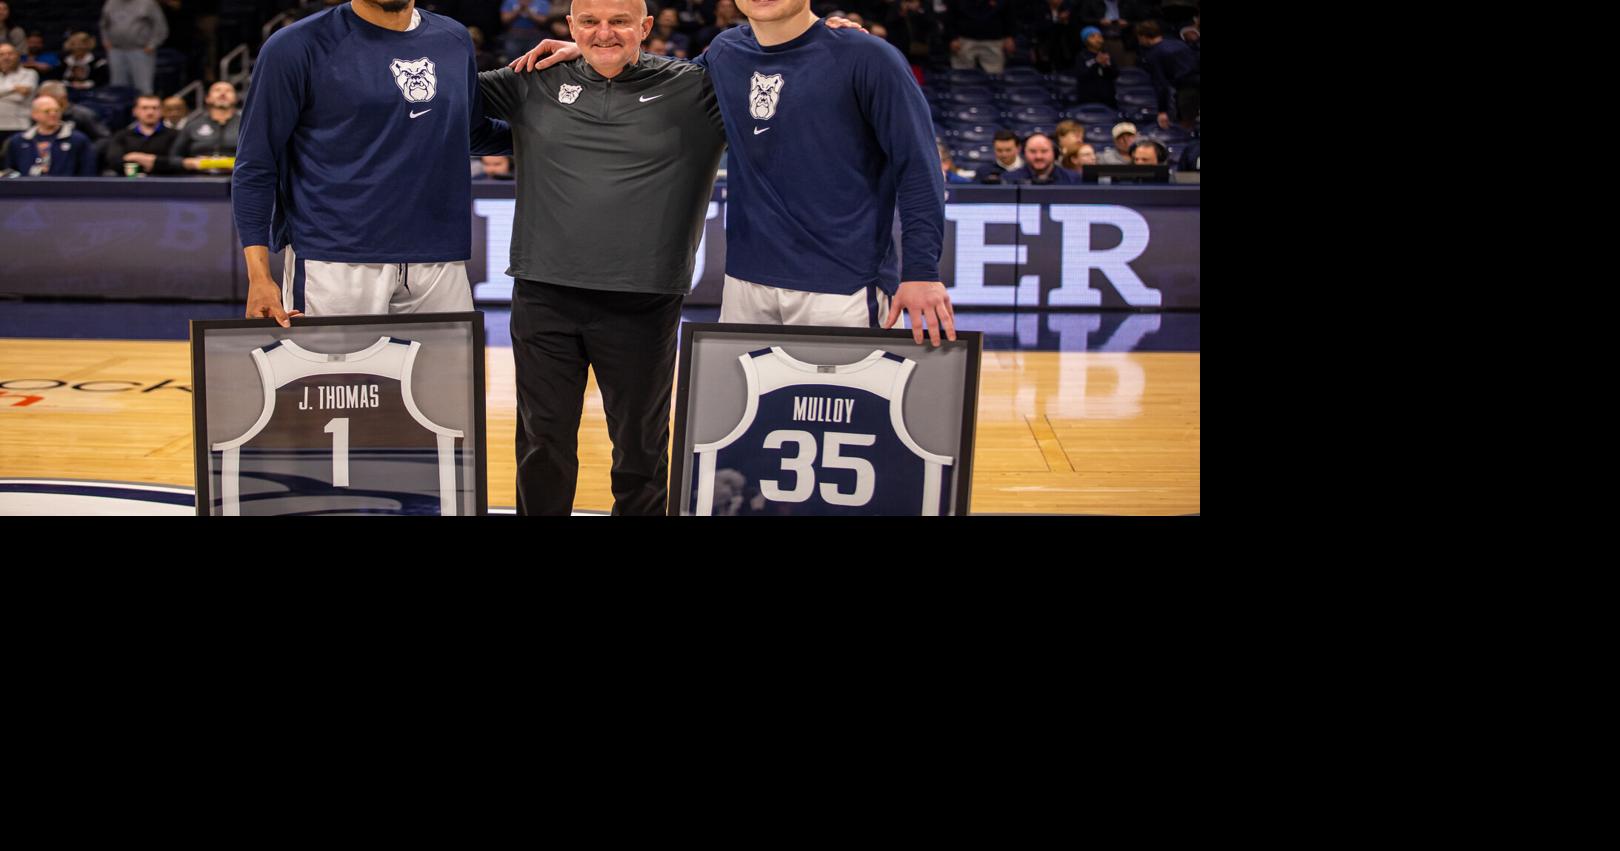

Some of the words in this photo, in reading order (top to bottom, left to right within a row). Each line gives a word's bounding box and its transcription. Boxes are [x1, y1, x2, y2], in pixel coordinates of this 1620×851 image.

[298, 385, 312, 410] J.
[318, 384, 379, 409] THOMAS
[792, 396, 855, 423] MULLOY
[324, 417, 349, 487] 1
[759, 429, 876, 507] 35
